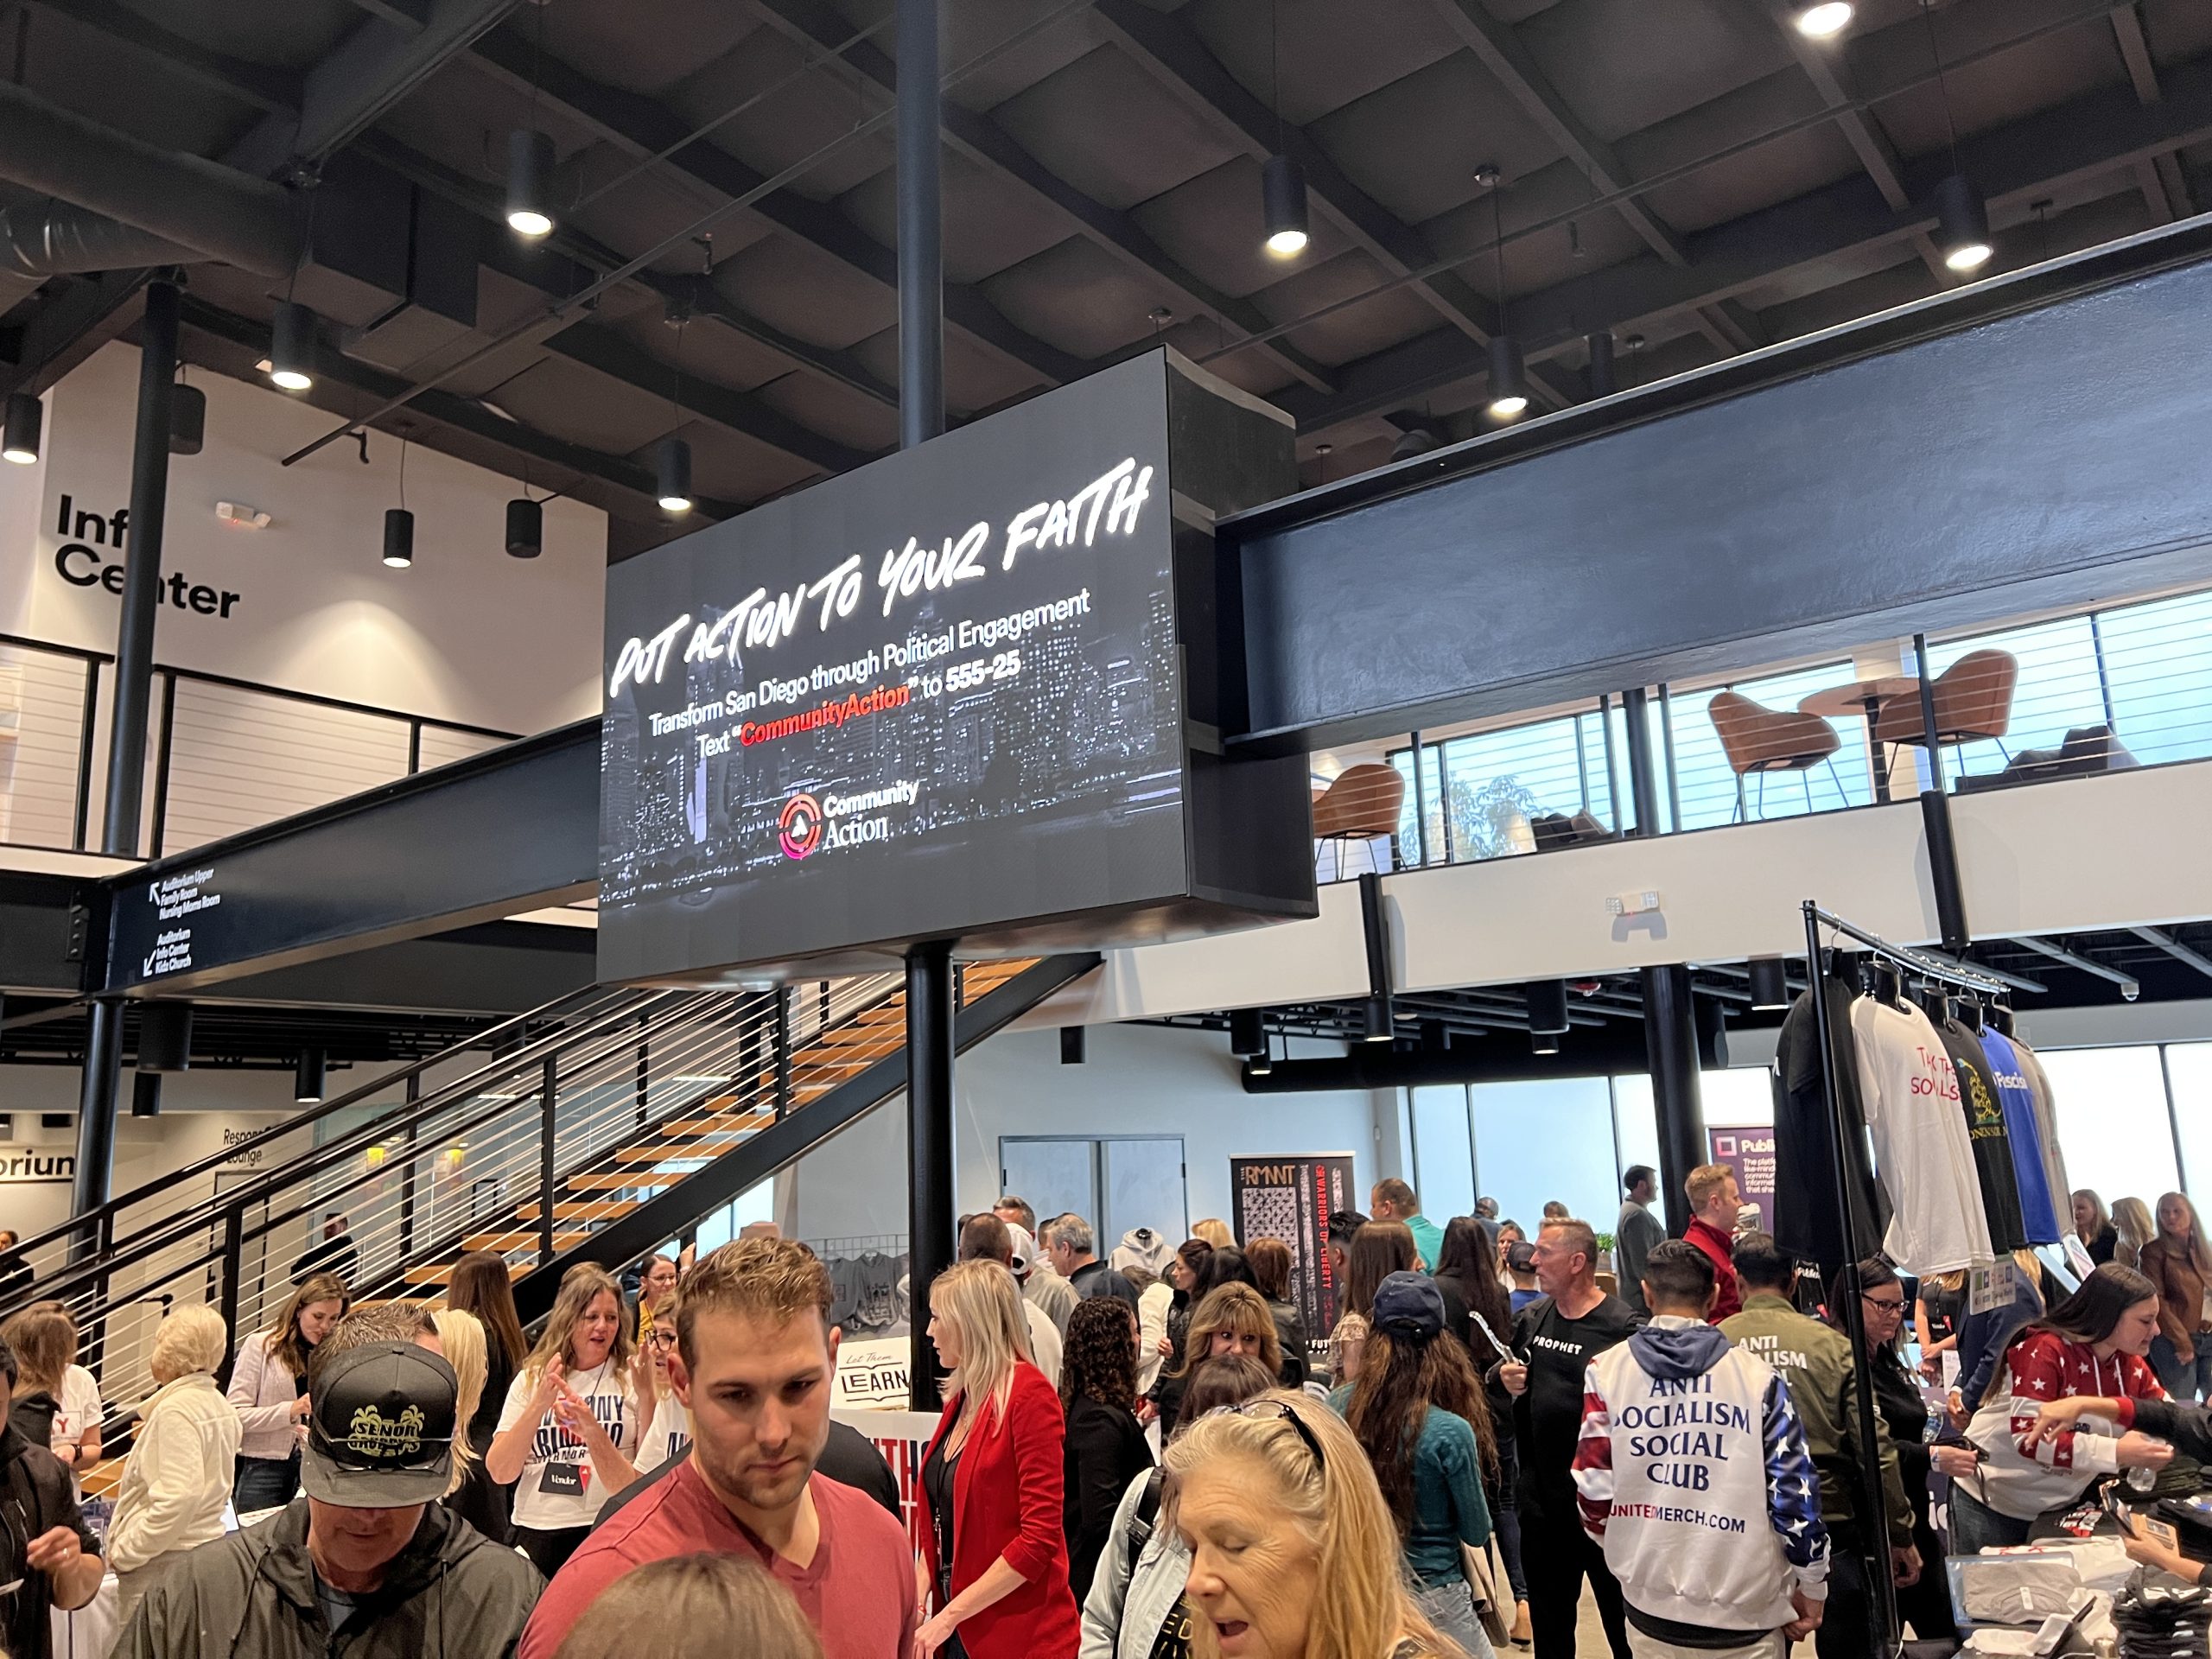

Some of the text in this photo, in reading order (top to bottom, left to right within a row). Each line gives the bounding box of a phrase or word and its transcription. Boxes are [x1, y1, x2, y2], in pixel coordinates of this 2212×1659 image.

[57, 493, 130, 548] Inf
[610, 457, 1154, 698] PUT ACTION TO YOUR FAITH
[649, 588, 1090, 736] Transform San Diego through Political Engagement
[696, 730, 731, 757] Text
[922, 675, 943, 699] to
[945, 649, 1021, 692] 555-25
[823, 779, 919, 818] Community
[823, 813, 889, 850] Action
[194, 868, 214, 885] Upper
[180, 887, 198, 901] Room
[201, 894, 221, 908] Room
[224, 1127, 271, 1145] Respo
[226, 1149, 263, 1166] ounge
[1316, 1176, 1328, 1227] WARRIORS
[1533, 1336, 1583, 1355] PROPHET
[1738, 1335, 1777, 1351] ANTI
[847, 1352, 893, 1363] Let Them
[841, 1370, 910, 1393] LEARN
[1630, 1432, 1729, 1461] SOCIAL
[551, 1474, 576, 1485] Vendor
[1647, 1463, 1710, 1491] CLUB
